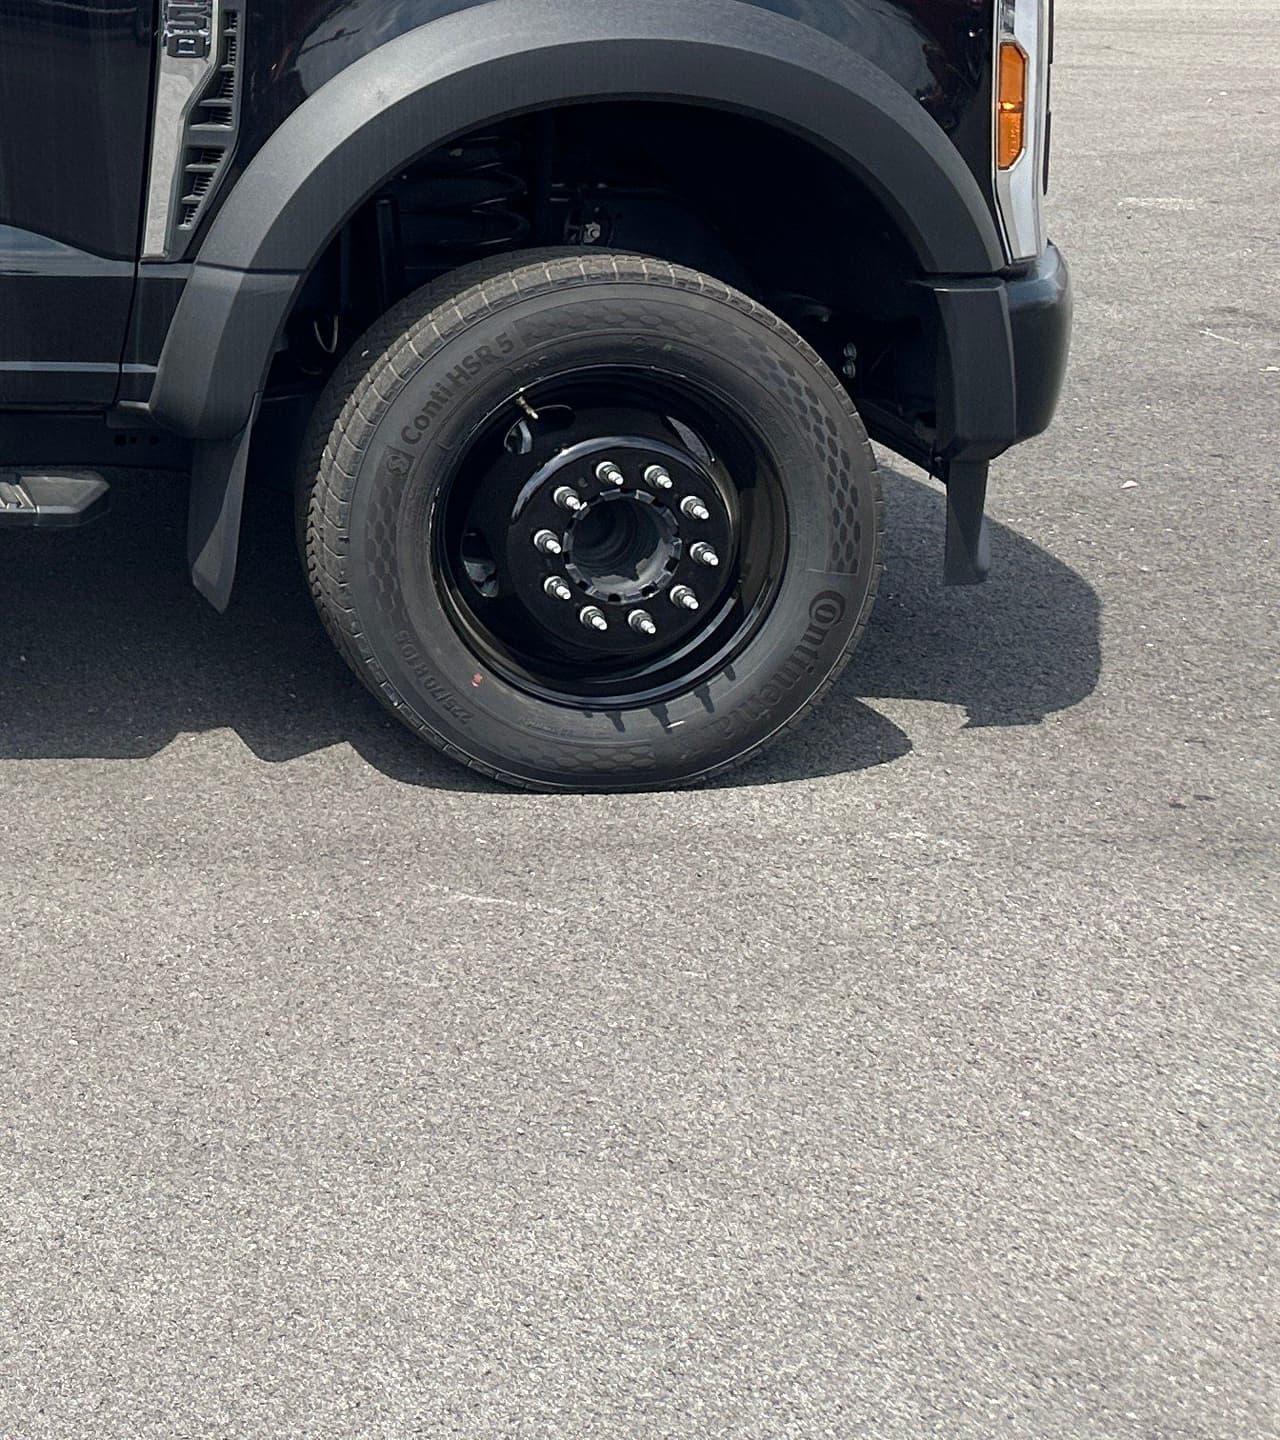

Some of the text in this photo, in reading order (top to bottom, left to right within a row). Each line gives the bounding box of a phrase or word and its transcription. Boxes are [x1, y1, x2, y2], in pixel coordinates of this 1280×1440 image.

[400, 381, 454, 445] Conti
[445, 344, 503, 389] HSR
[494, 332, 515, 354] 5
[703, 589, 847, 752] Continenta
